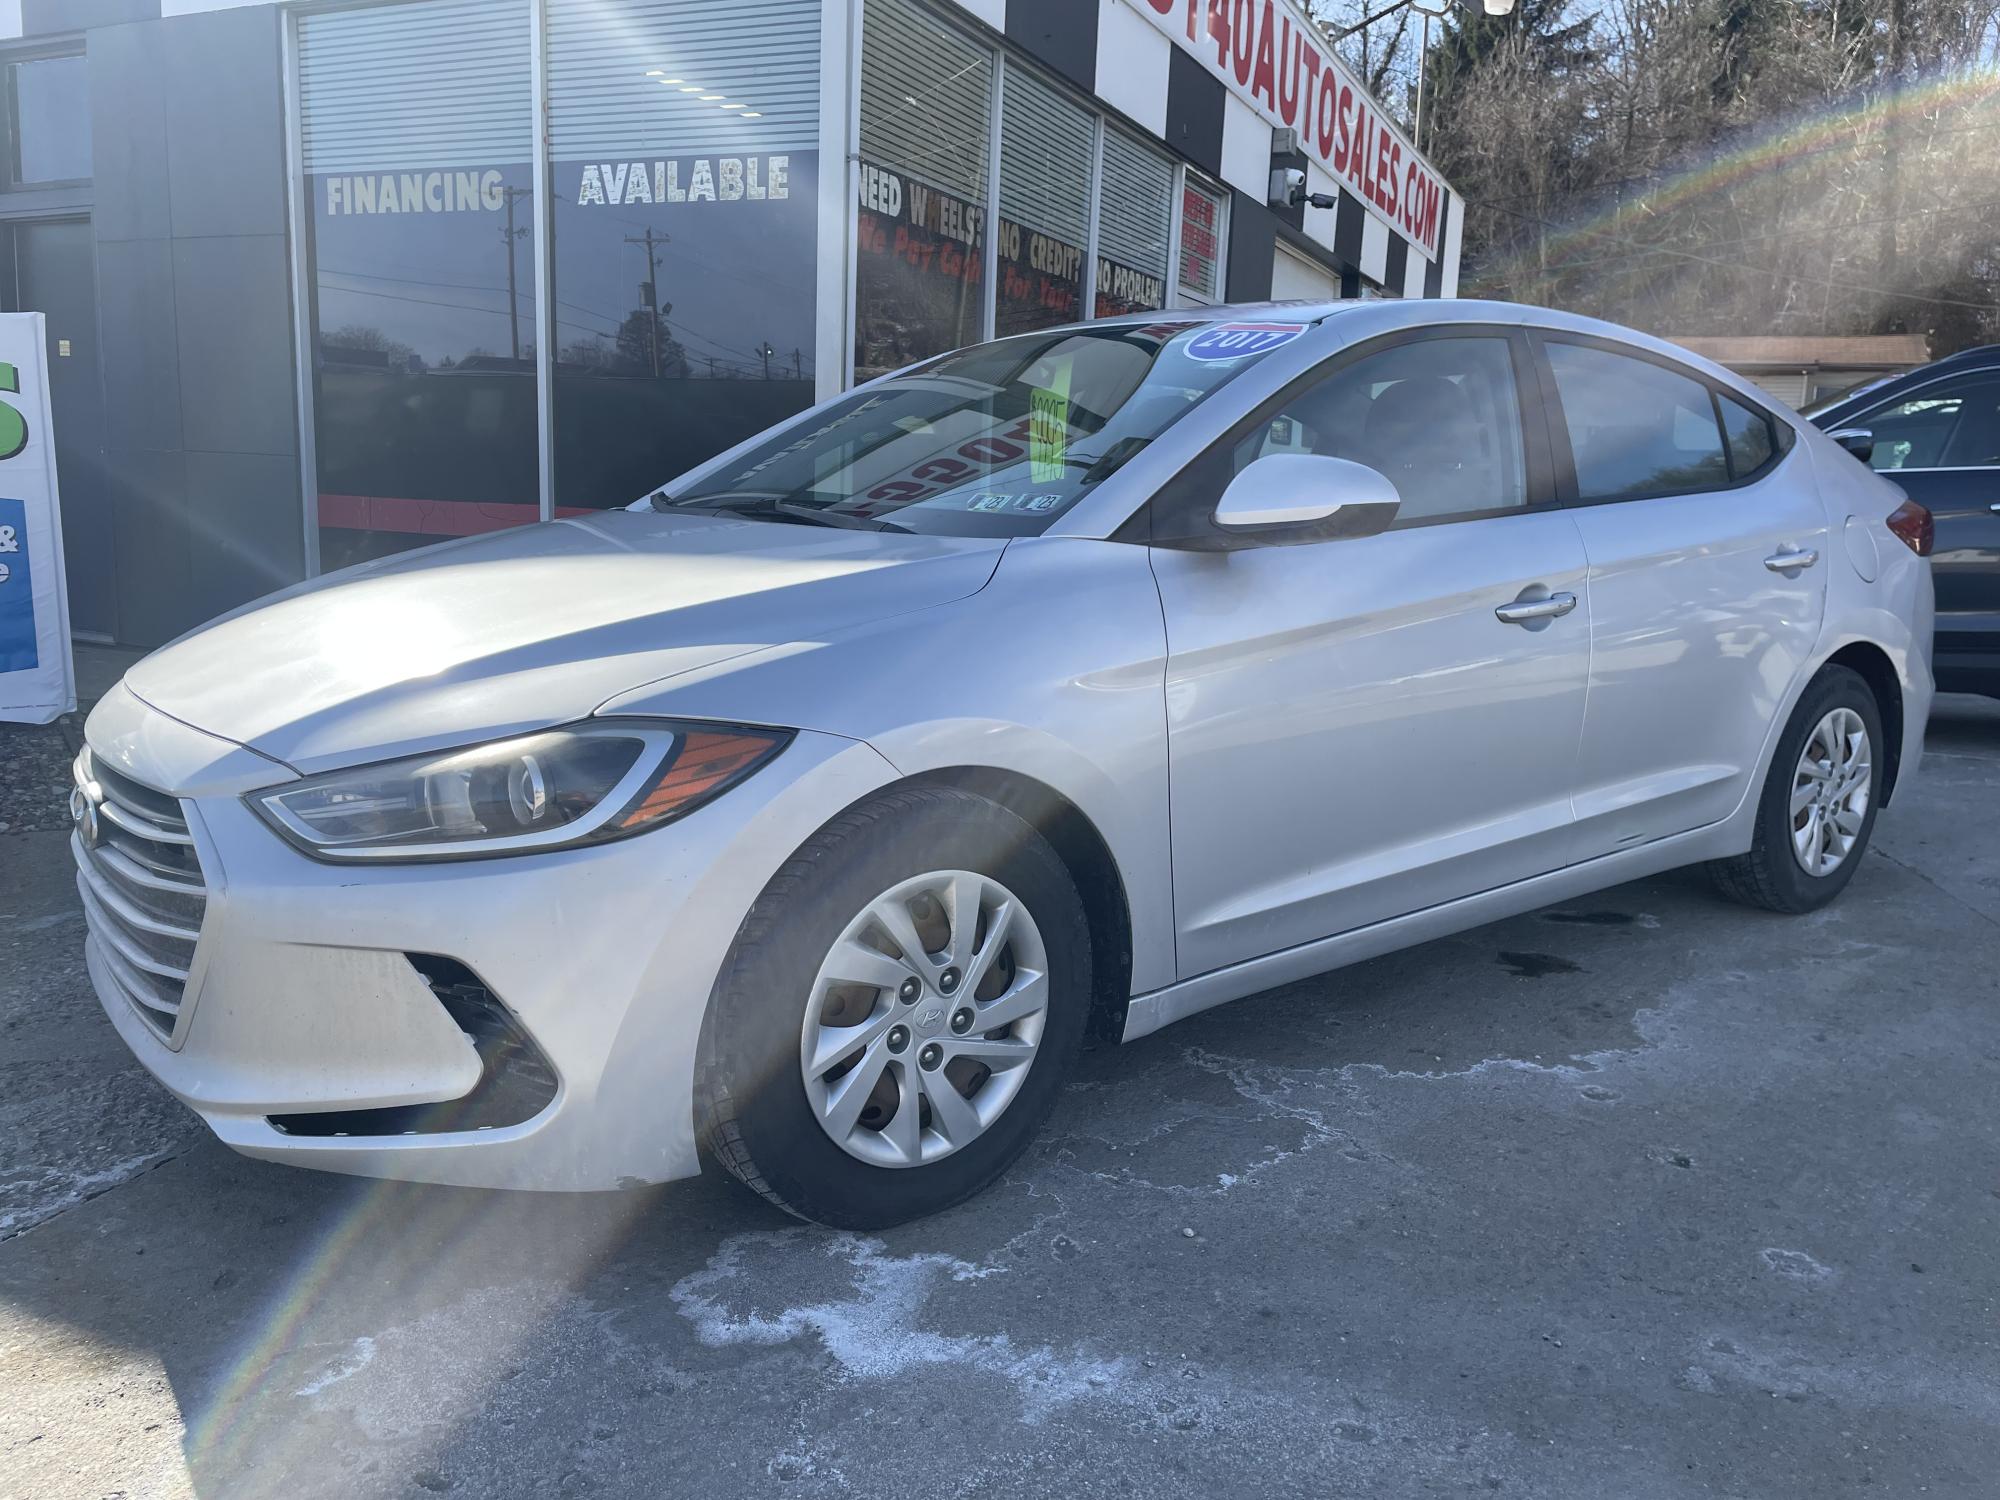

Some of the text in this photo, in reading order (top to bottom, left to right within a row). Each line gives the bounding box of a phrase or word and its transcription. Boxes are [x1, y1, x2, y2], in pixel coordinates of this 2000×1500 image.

[1146, 0, 1440, 251] 40AUTOSALES.COM
[326, 156, 790, 216] FINANCING AVAILABLE
[859, 163, 902, 217] NEED
[910, 182, 985, 249] WHEELS?
[999, 219, 1021, 262] NO
[1030, 233, 1082, 283] CREDIT?
[1114, 266, 1163, 309] PROBLEM!
[1195, 331, 1287, 350] 2017
